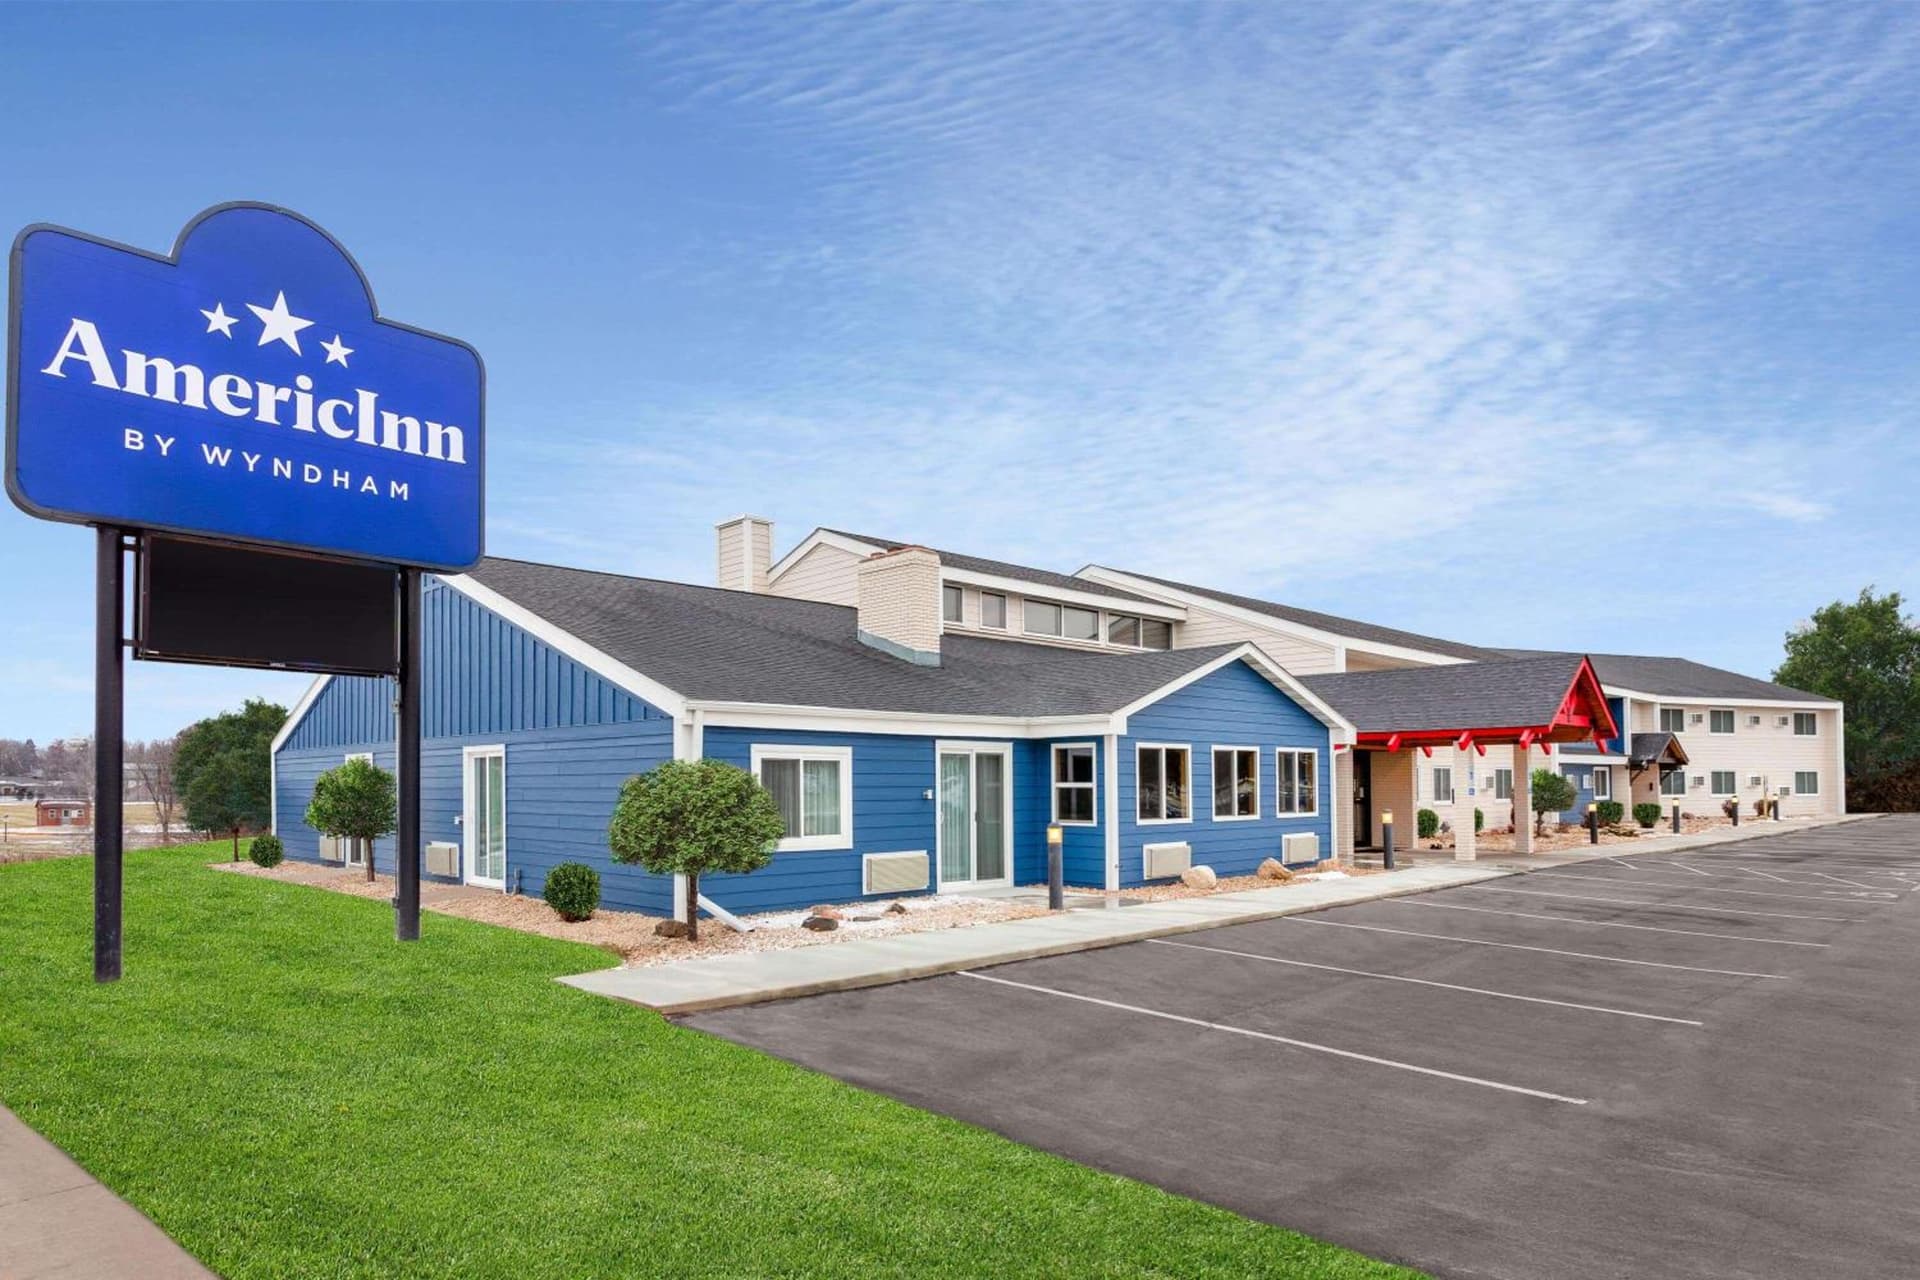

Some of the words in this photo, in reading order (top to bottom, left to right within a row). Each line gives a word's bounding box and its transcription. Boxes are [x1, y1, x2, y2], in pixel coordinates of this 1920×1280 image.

[41, 318, 466, 464] AmericInn
[124, 428, 175, 456] BY
[202, 443, 409, 501] WYNDHAM
